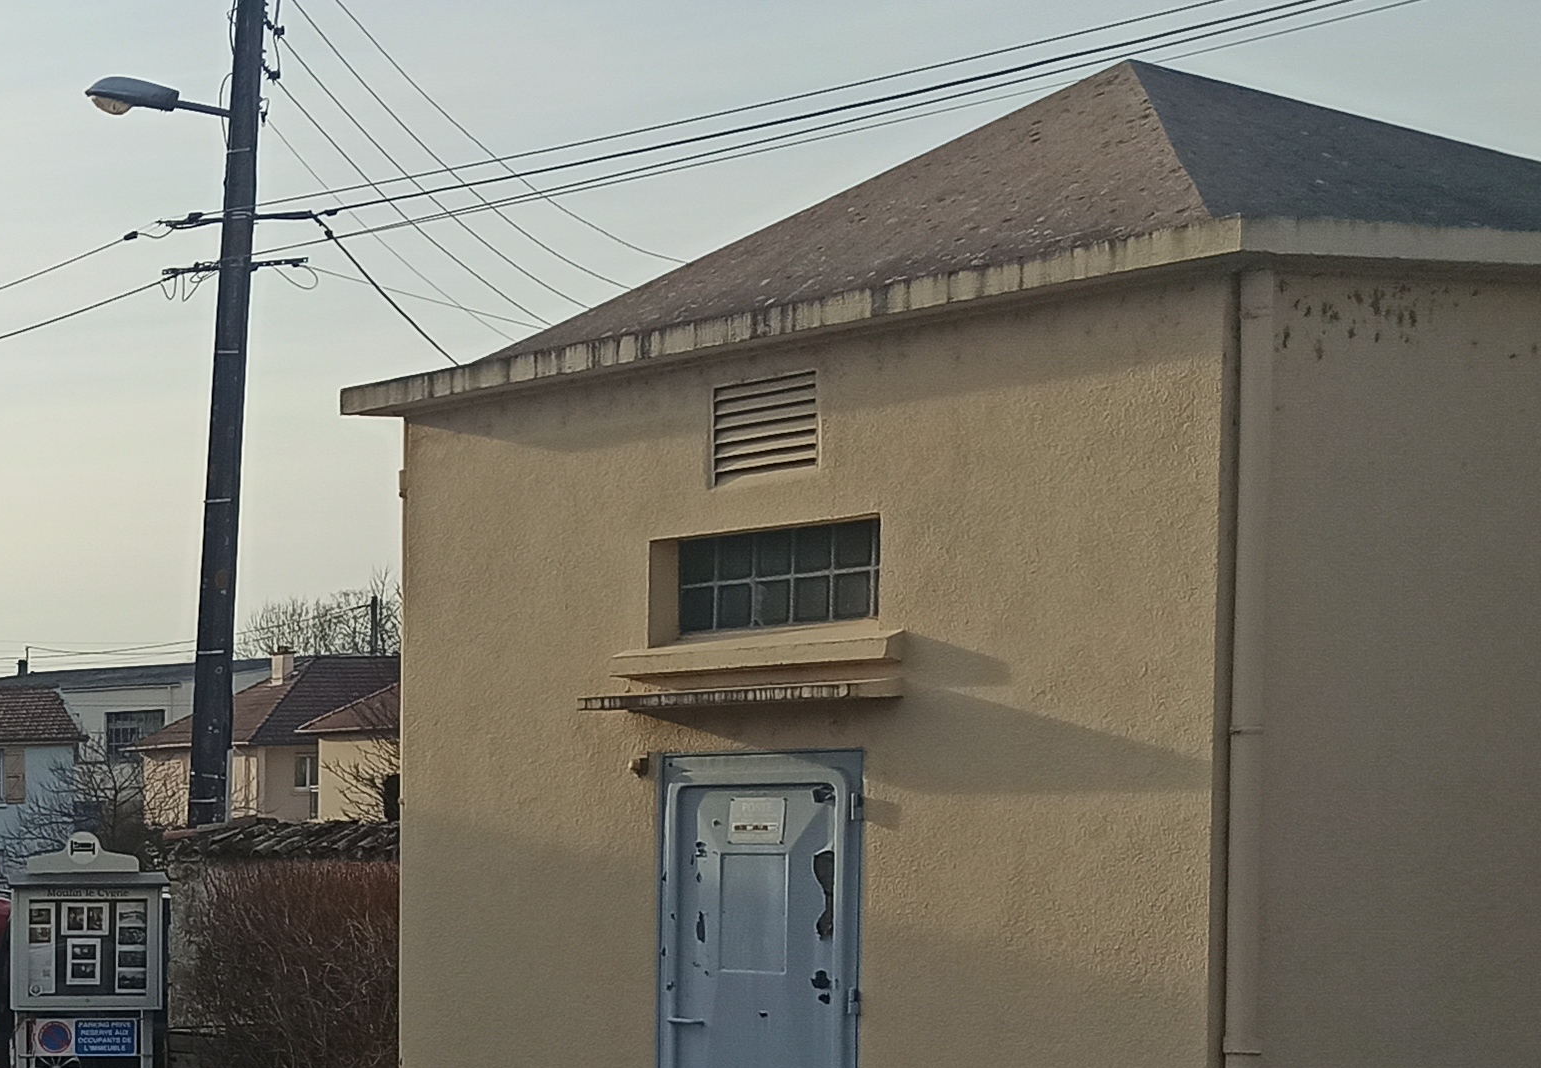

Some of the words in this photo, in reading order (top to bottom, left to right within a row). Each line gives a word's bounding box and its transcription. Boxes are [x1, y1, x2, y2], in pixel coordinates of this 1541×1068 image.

[742, 802, 773, 812] POSTE
[47, 888, 82, 897] Moulin
[85, 888, 94, 897] le
[97, 888, 129, 898] Cygne
